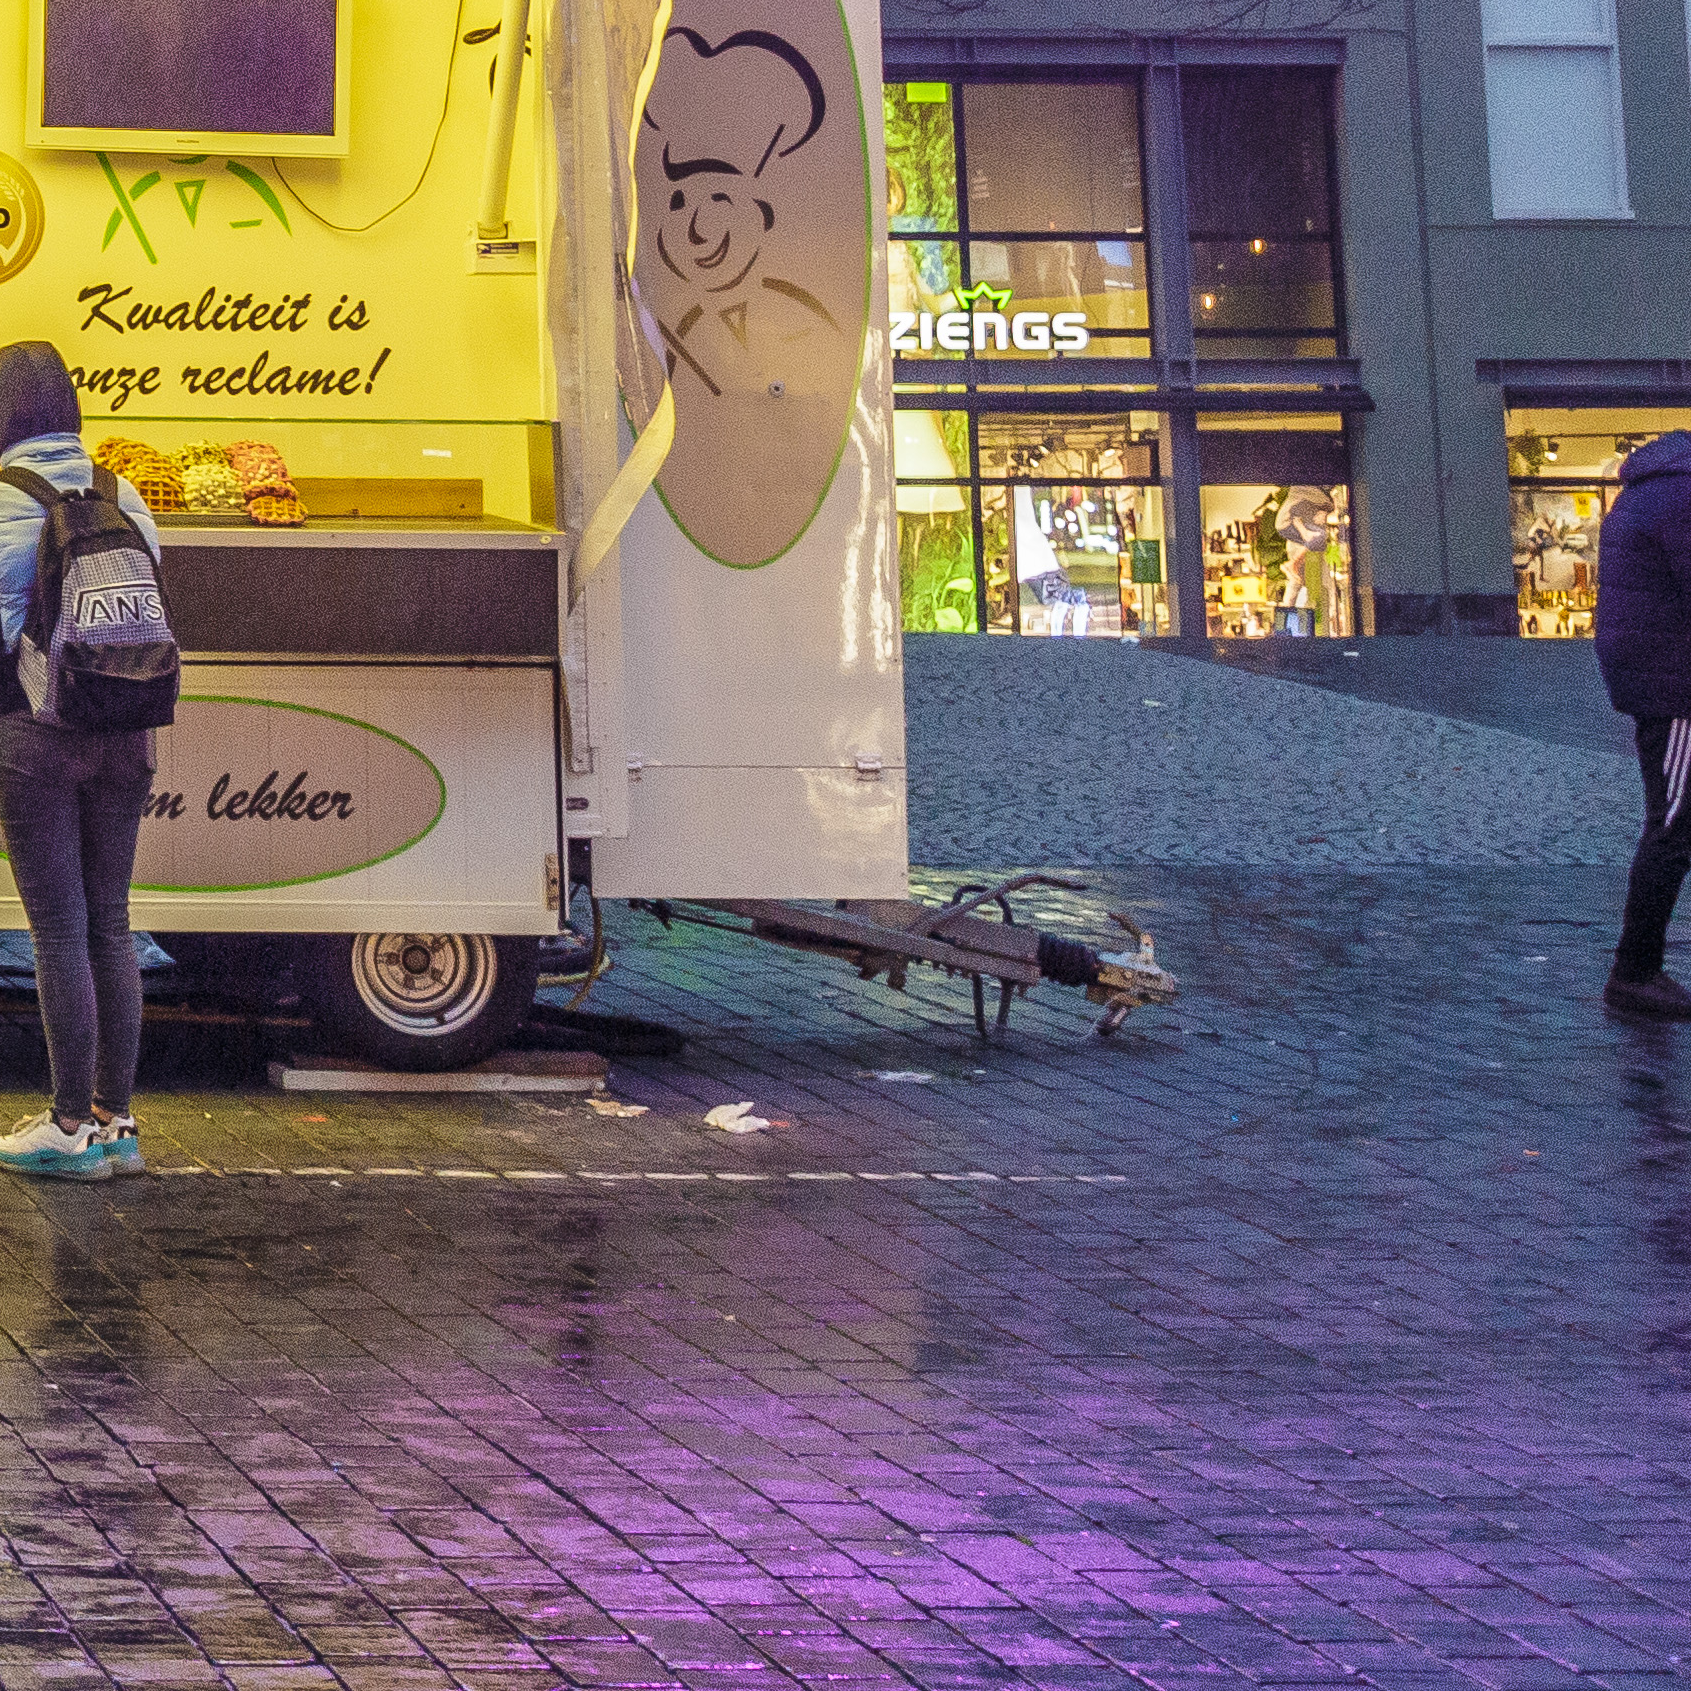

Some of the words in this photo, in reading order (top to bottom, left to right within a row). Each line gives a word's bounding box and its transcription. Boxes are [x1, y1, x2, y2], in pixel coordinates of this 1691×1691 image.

[77, 283, 313, 334] Kwaliteit
[328, 294, 370, 332] is
[889, 311, 1090, 351] ZIENGS
[181, 347, 392, 396] reclame!
[206, 770, 355, 821] lekker
